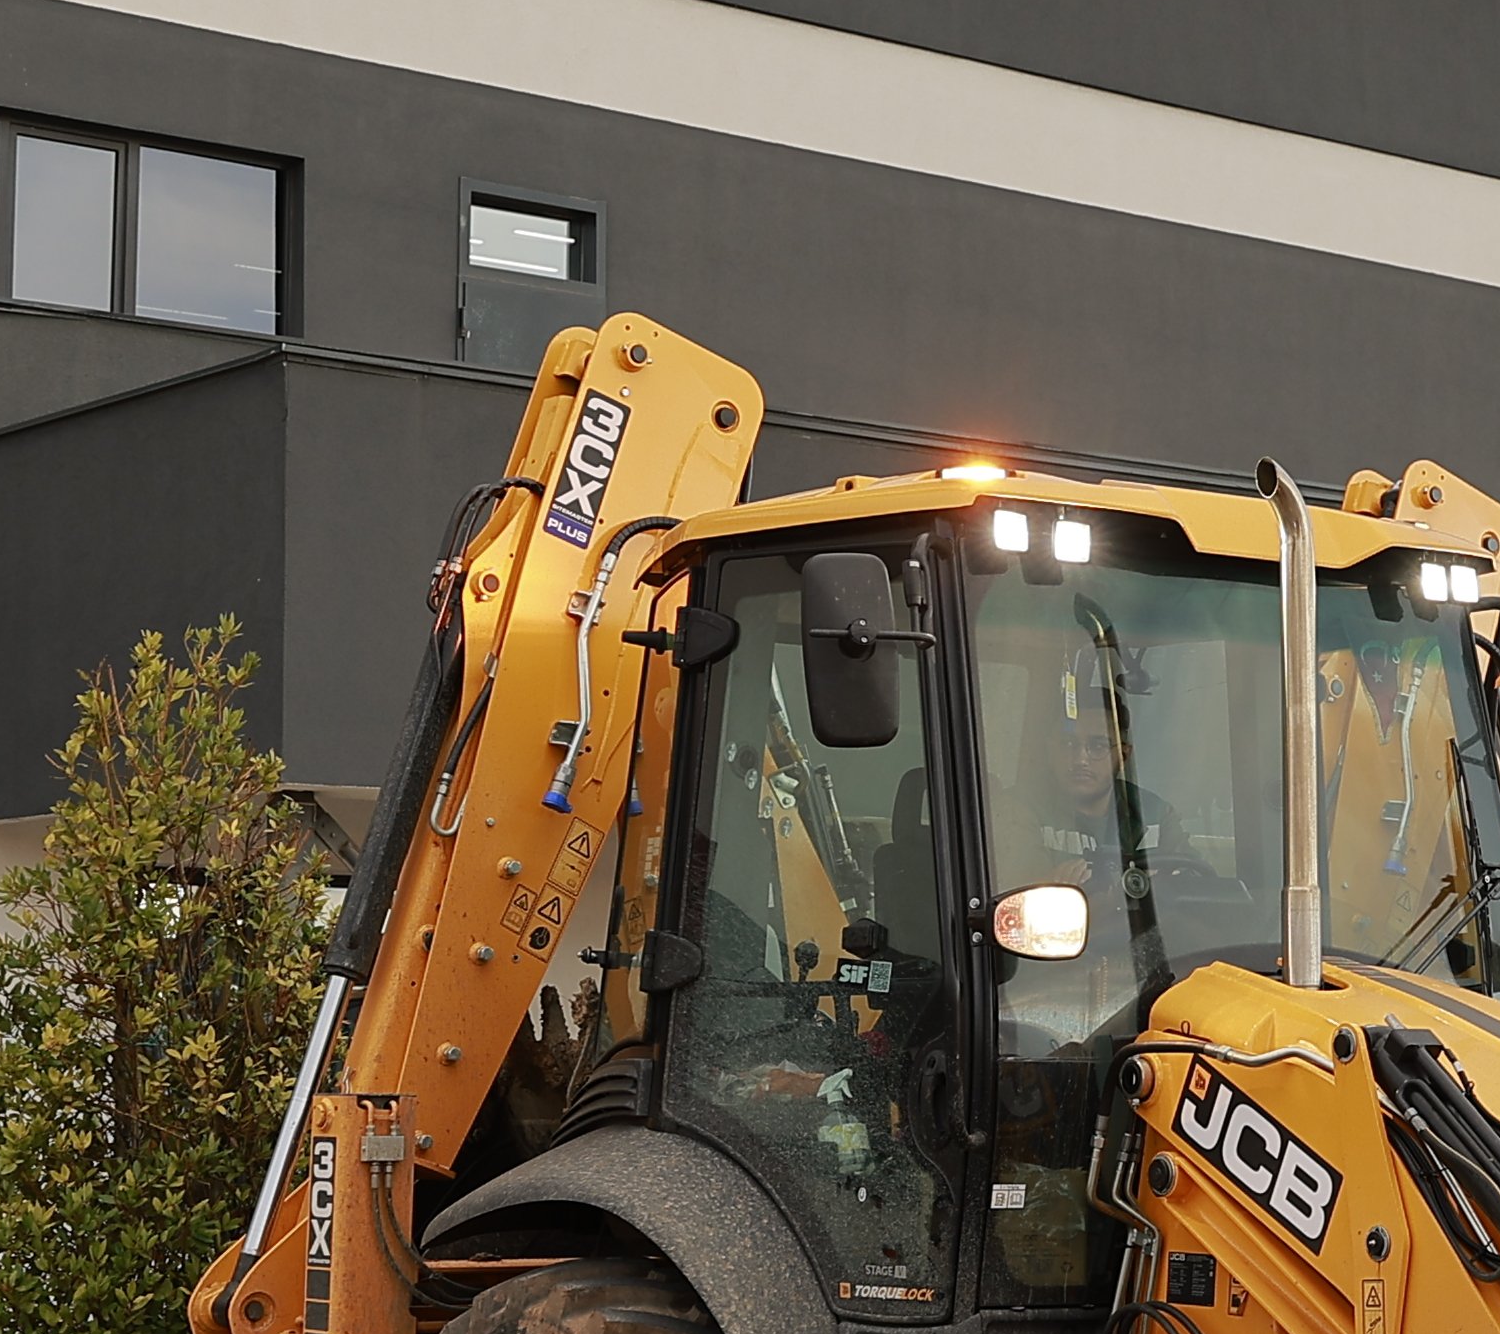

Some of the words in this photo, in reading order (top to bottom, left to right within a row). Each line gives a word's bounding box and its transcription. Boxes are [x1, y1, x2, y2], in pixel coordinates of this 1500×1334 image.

[554, 397, 624, 518] 3CX
[547, 517, 588, 543] PLUS
[1180, 1082, 1333, 1240] JCB
[309, 1141, 334, 1256] 3CX
[854, 1284, 935, 1302] TORQUELOCK
[865, 1264, 894, 1276] STAGE
